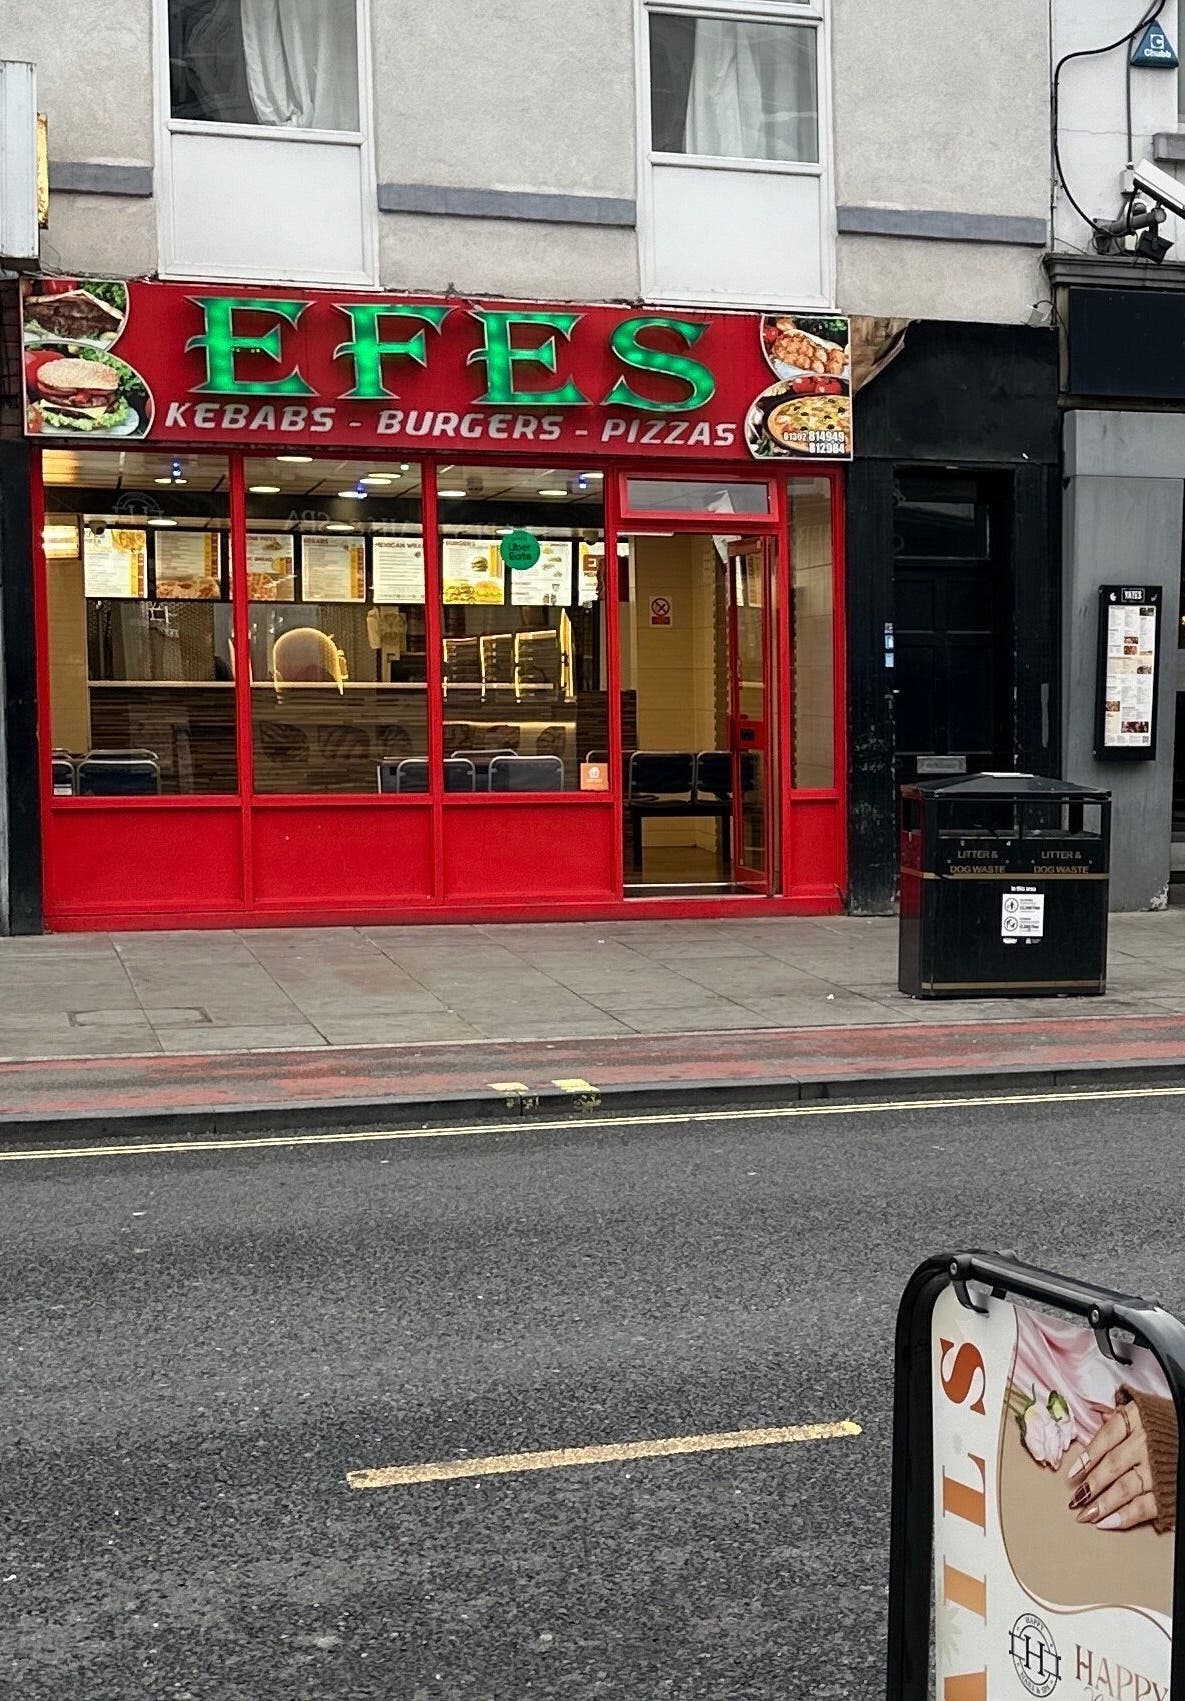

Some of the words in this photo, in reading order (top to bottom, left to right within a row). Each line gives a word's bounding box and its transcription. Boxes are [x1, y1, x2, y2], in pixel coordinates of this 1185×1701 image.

[1144, 48, 1172, 59] Chubb
[184, 295, 717, 413] EFES
[165, 401, 336, 432] KEBABS
[376, 409, 565, 441] BURGERS
[601, 418, 738, 447] PIZZAS
[808, 430, 845, 442] 814949
[809, 442, 845, 454] 812984
[1123, 590, 1143, 600] YATES
[957, 850, 990, 860] LITTER
[991, 850, 999, 859] &
[1041, 850, 1073, 860] LITTER
[1074, 850, 1082, 860] &
[949, 865, 976, 874] DOG
[975, 865, 1006, 874] WASTE
[1033, 865, 1055, 874] DOG
[1055, 865, 1090, 874] WASTE
[1074, 1643, 1169, 1701] HAPPY
